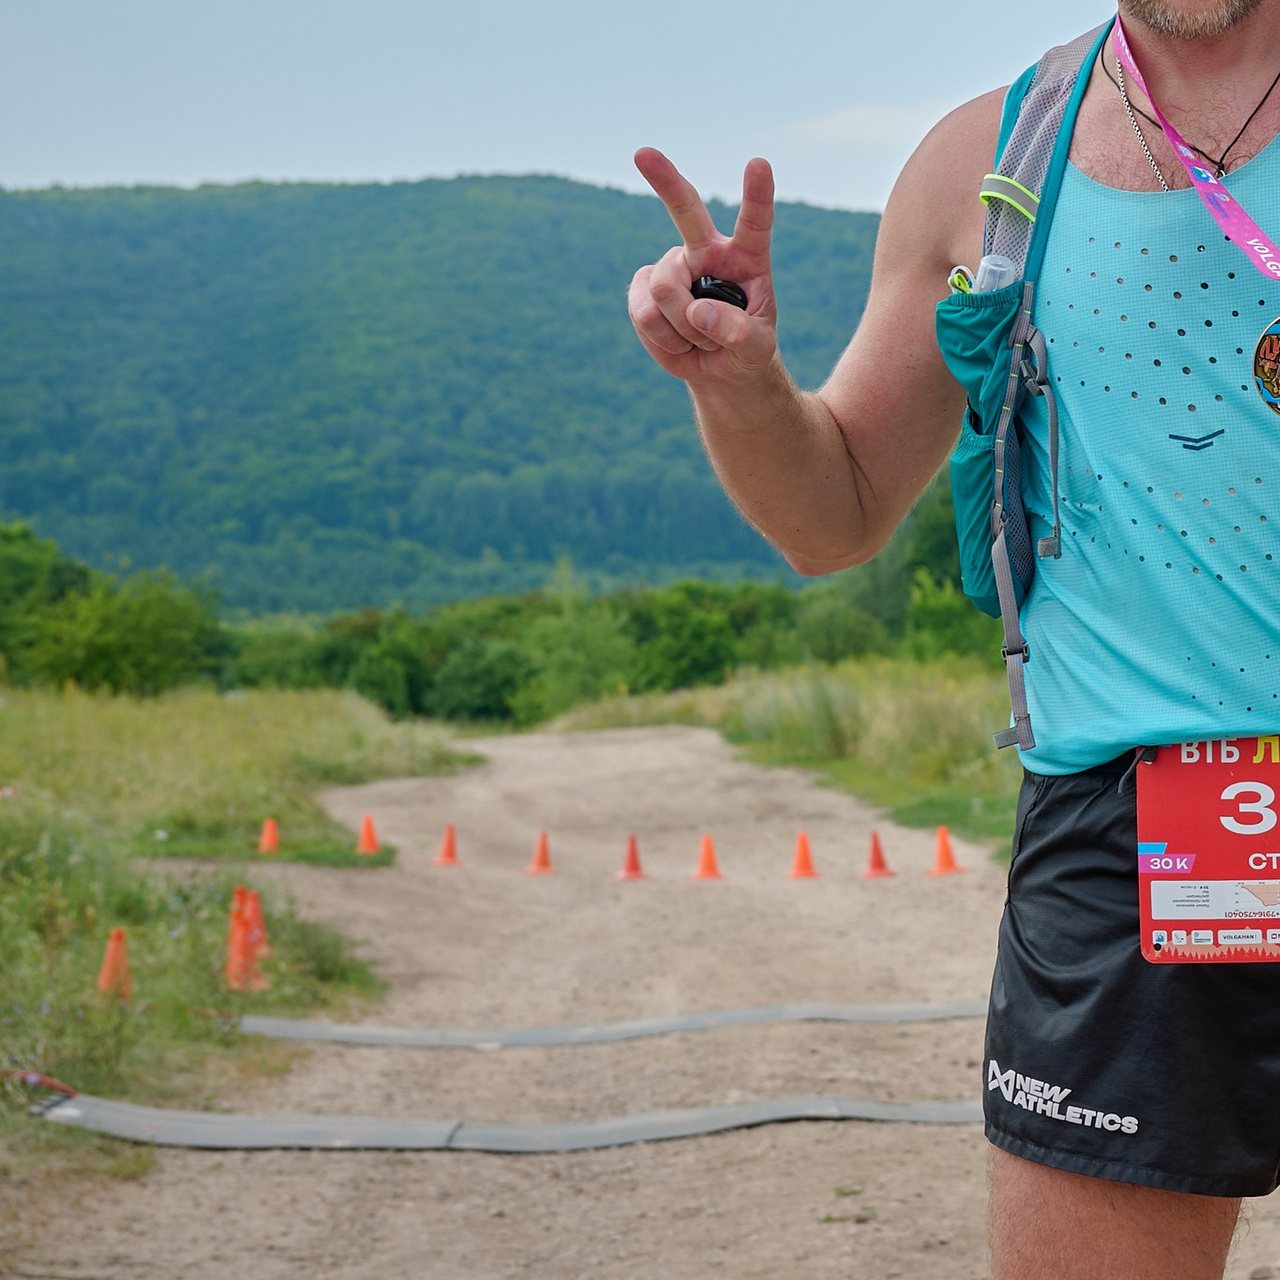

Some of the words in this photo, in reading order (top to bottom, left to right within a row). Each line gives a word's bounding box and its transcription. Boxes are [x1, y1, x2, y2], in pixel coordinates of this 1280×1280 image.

[1150, 857, 1173, 870] 30
[1016, 1074, 1072, 1103] NEW
[1014, 1091, 1139, 1134] ATHLETICS
